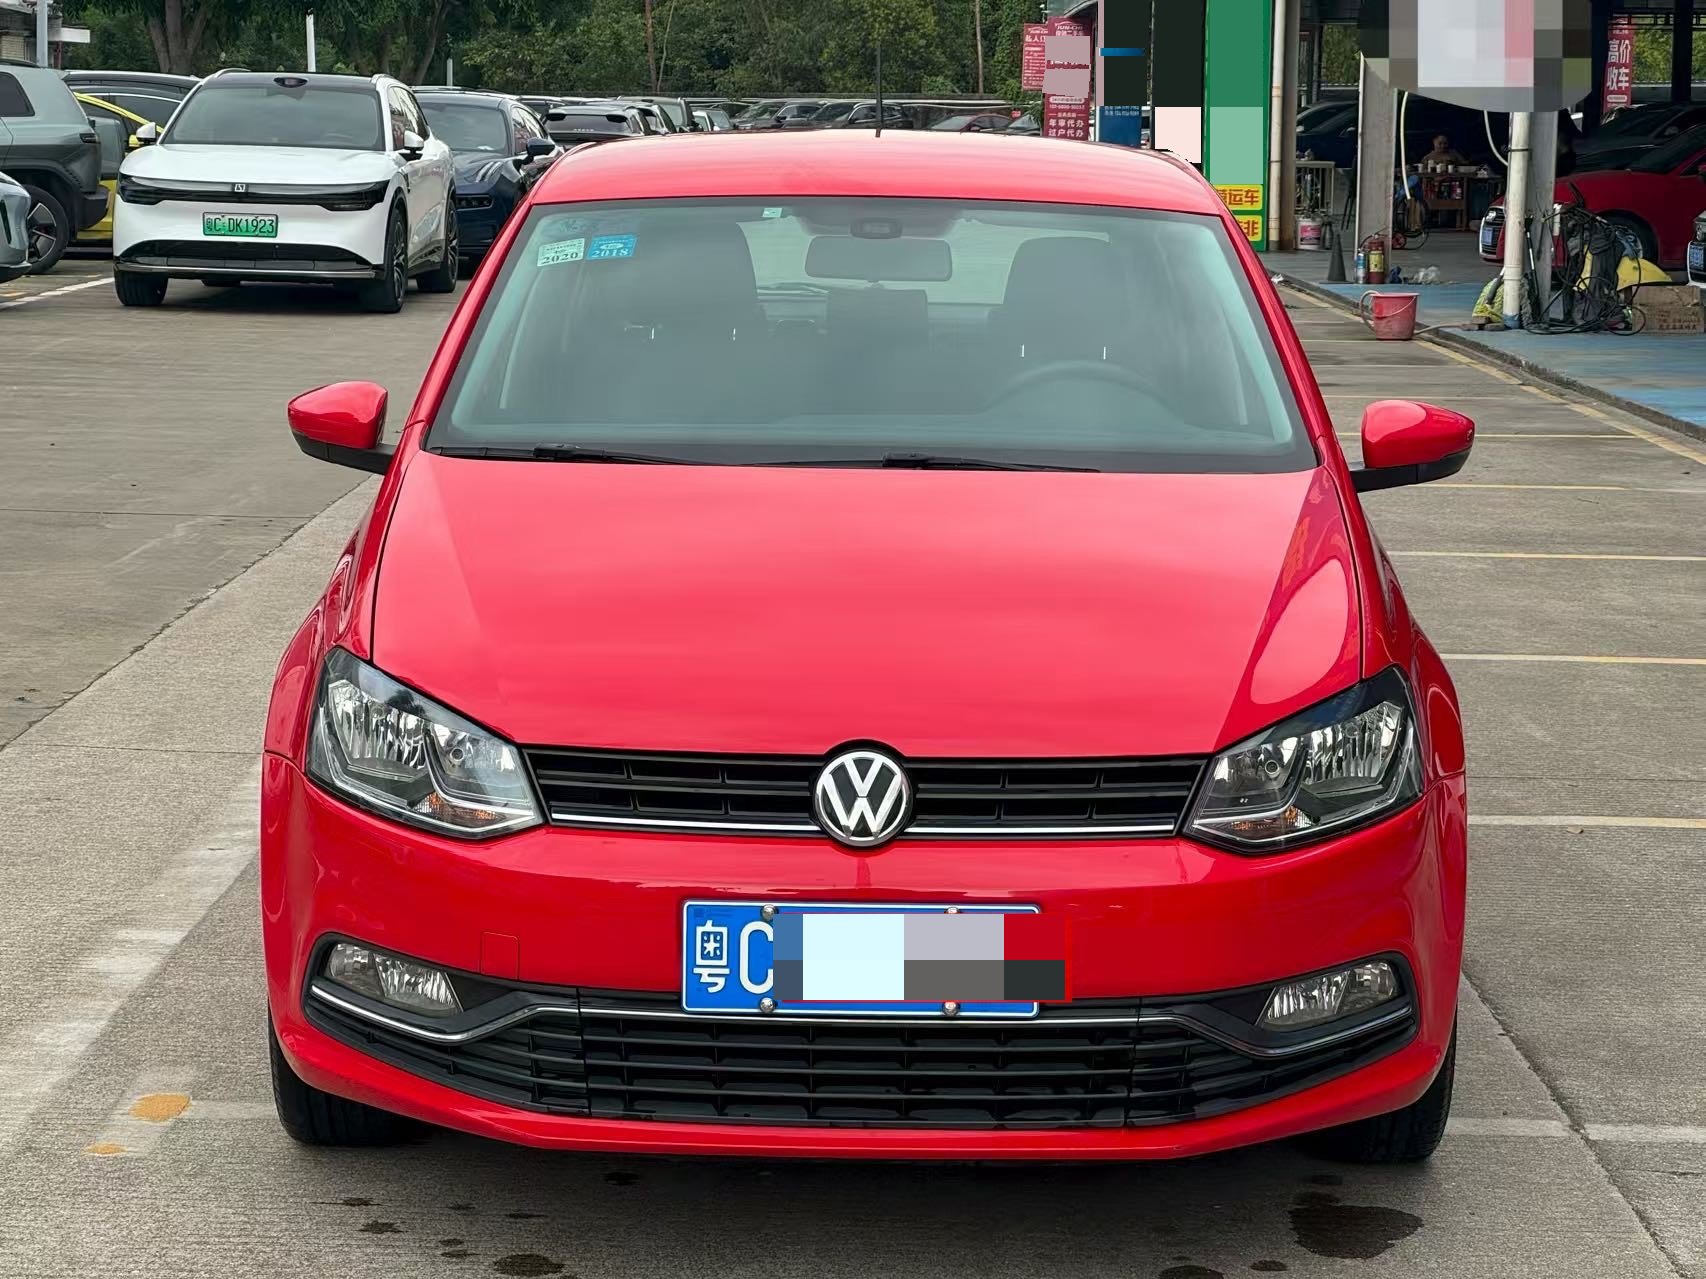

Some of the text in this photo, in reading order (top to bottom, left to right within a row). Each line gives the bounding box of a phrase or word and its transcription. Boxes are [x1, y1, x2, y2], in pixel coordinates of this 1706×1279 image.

[1608, 39, 1631, 63] 高价
[1607, 66, 1630, 90] 收车
[1048, 118, 1085, 128] 年审代办
[1048, 128, 1084, 137] 过户代办
[541, 252, 579, 265] 2020
[591, 248, 629, 258] 2018
